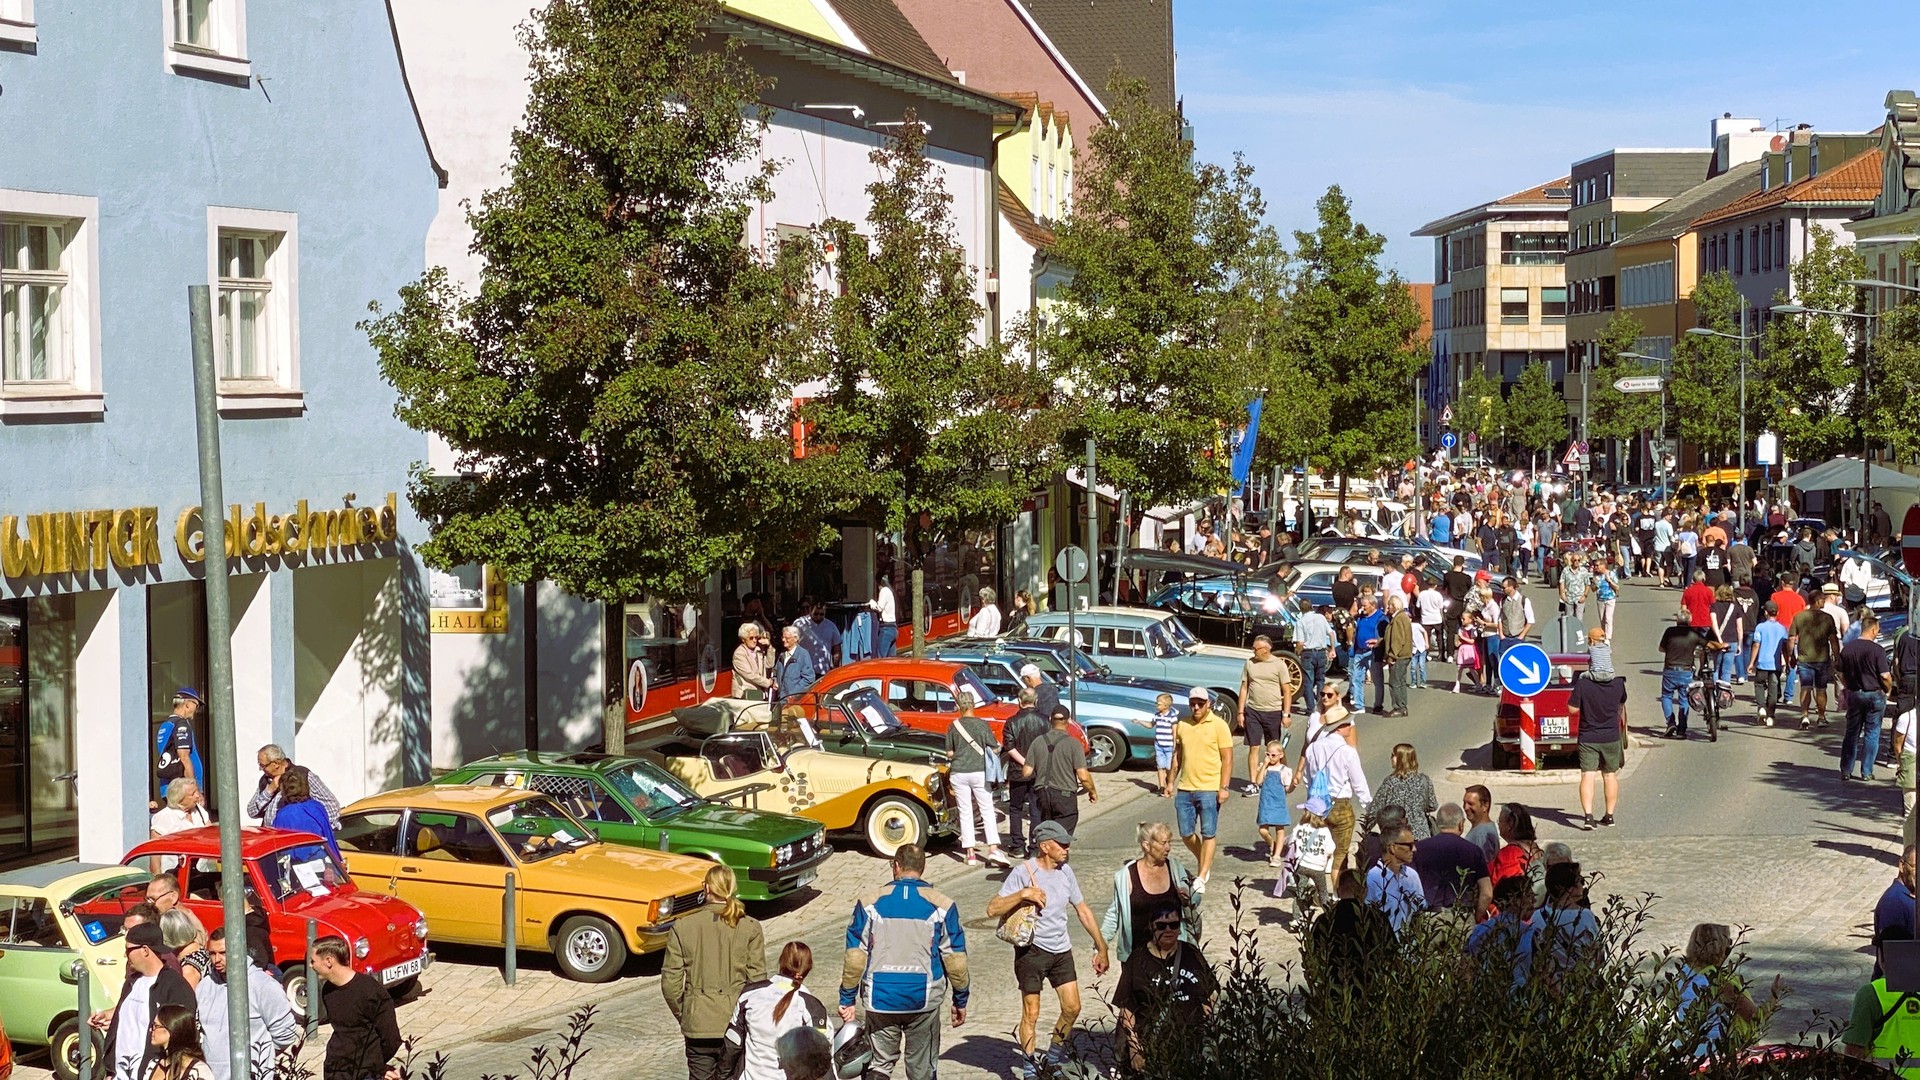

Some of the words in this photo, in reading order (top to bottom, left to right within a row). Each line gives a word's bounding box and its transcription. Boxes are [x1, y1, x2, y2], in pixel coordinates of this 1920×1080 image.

[1, 506, 162, 578] WINTER
[411, 960, 419, 972] 68
[881, 964, 920, 972] SCOTT
